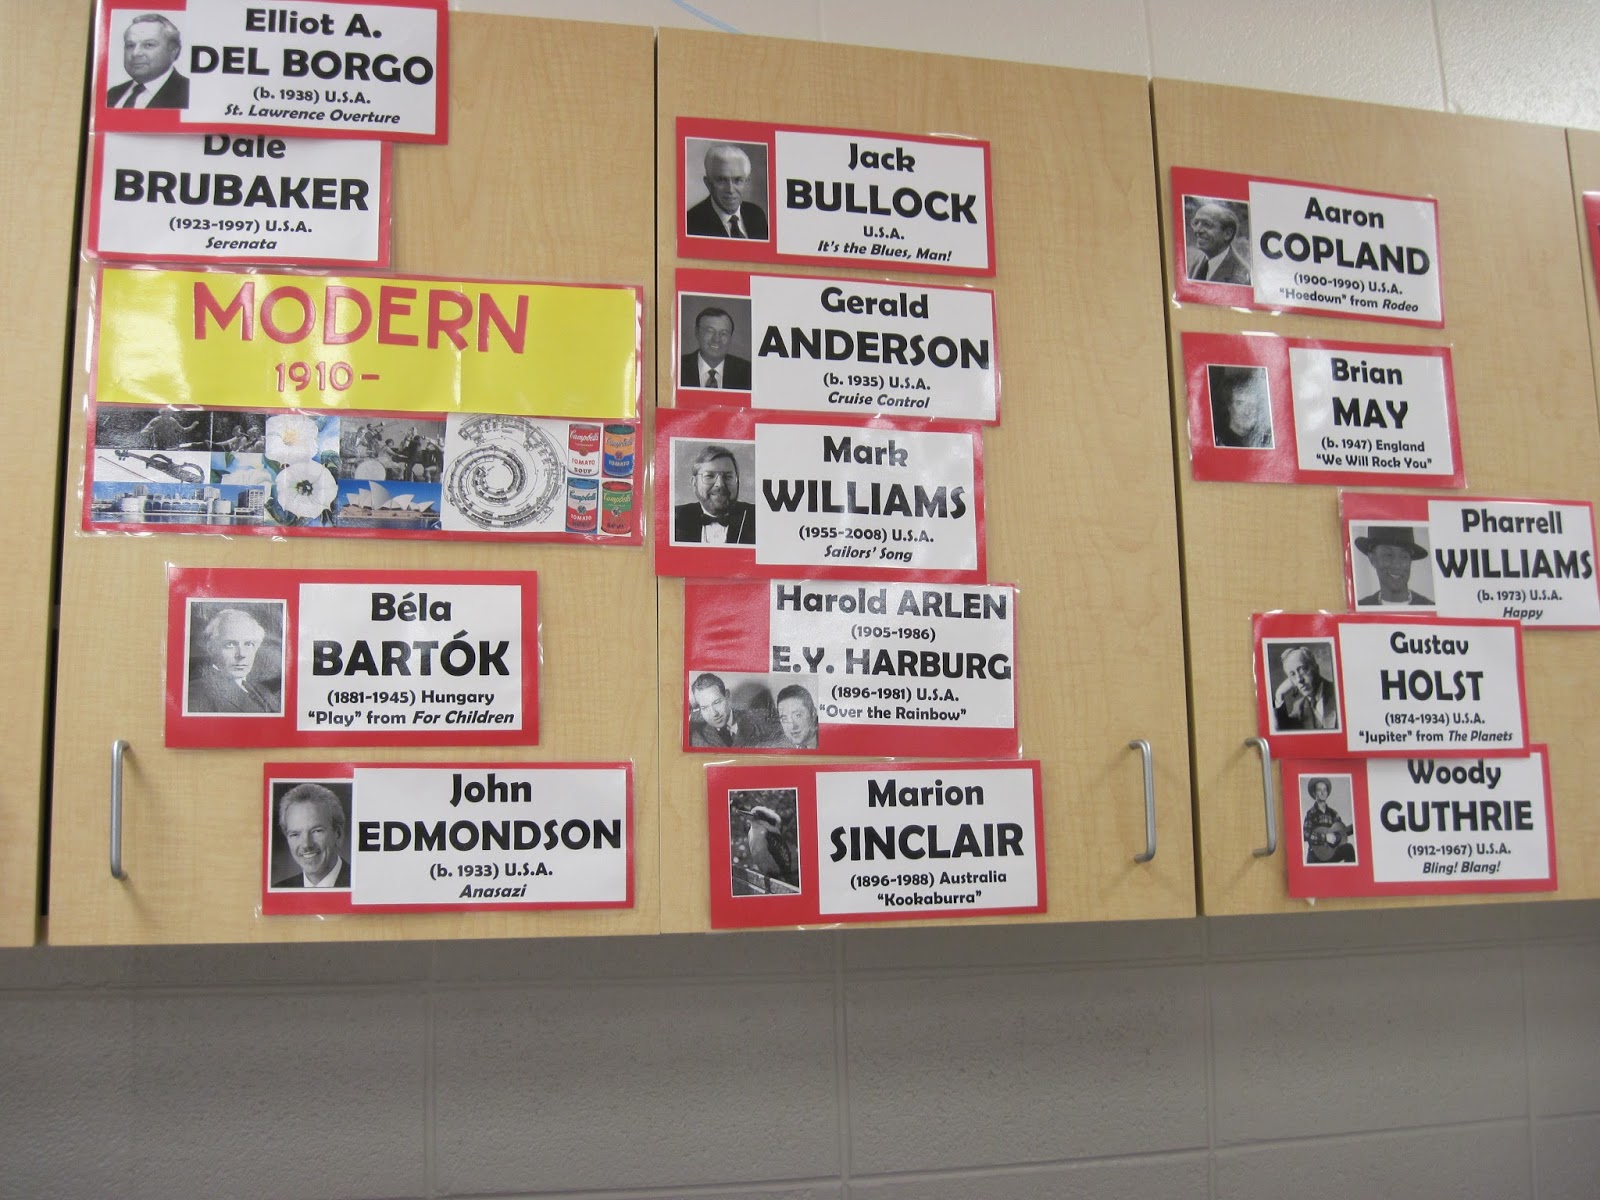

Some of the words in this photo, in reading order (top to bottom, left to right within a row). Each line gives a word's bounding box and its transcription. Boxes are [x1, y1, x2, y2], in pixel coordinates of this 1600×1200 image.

[246, 8, 334, 35] Elliot
[345, 14, 382, 38] A.
[191, 46, 269, 75] DEL
[283, 49, 433, 85] BORGO
[254, 87, 275, 101] (b.
[280, 89, 319, 104] 1938)
[325, 91, 370, 104] U.S.A.
[225, 104, 243, 115] St.
[248, 105, 325, 120] Lawrence
[330, 109, 400, 123] Overture
[204, 134, 286, 159] Dale
[848, 143, 915, 172] Jack
[114, 169, 369, 210] BRUBAKER
[787, 179, 977, 224] BULLOCK
[1305, 197, 1384, 229] Aaron
[170, 217, 260, 234] (1923-1997)
[266, 220, 312, 232] U.S.A.
[864, 226, 904, 239] U.S.A.
[206, 237, 277, 249] Serenata
[844, 242, 867, 254] the
[871, 244, 911, 259] Blues,
[916, 248, 952, 261] Man!
[1260, 231, 1430, 275] COPLAND
[1294, 273, 1364, 293] (1900-1990)
[1369, 281, 1402, 294] U.S.A.
[821, 287, 928, 319] Gerald
[1350, 295, 1378, 308] from
[1383, 299, 1418, 312] Rodeo
[193, 282, 529, 354] MODERN
[758, 326, 989, 369] ANDERSON
[824, 373, 843, 387] (b.
[848, 375, 884, 390] 1935)
[889, 376, 930, 390] U.S.A.
[1331, 358, 1402, 385] Brian
[828, 392, 873, 405] Cruise
[877, 394, 930, 408] Control
[1332, 397, 1408, 429] MAY
[824, 436, 908, 466] Mark
[1322, 437, 1338, 450] (b.
[1342, 439, 1372, 452] 1947)
[1376, 440, 1425, 453] England
[1346, 455, 1368, 466] Will
[1372, 456, 1400, 467] Rock
[763, 479, 966, 519] WILLIAMS
[1461, 509, 1562, 534] Pharrell
[799, 525, 887, 543] (1955-2008)
[892, 529, 934, 542] U.S.A.
[879, 547, 912, 562] Song
[1435, 549, 1592, 579] WILLIAMS
[372, 592, 451, 621] Béla
[777, 585, 886, 614] Harold
[897, 590, 1006, 619] ARLEN
[1477, 590, 1493, 603] (b.
[1497, 590, 1526, 603] 1973)
[1530, 590, 1562, 600] U.S.A.
[1503, 607, 1543, 620] Happy
[852, 625, 935, 643] (1905-1986)
[1390, 631, 1468, 655] Gustav
[313, 630, 509, 676] BARTÓK
[773, 646, 834, 673] E.Y.
[846, 649, 1011, 680] HARBURG
[832, 685, 911, 703] (1896-1981)
[917, 688, 959, 701] U.S.A.
[1381, 670, 1483, 701] HOLST
[328, 690, 415, 706] (1881-1945)
[422, 690, 494, 705] Hungary
[367, 711, 405, 724] from
[413, 711, 441, 724] For
[445, 710, 514, 724] Children
[867, 706, 891, 719] the
[1385, 712, 1449, 726] (1874-1934)
[1453, 713, 1485, 724] U.S.A.
[1416, 730, 1443, 741] from
[1449, 730, 1467, 741] The
[1471, 730, 1512, 741] Planets
[1407, 759, 1501, 789] Woody
[450, 773, 531, 807] John
[868, 779, 983, 807] Marion
[1380, 801, 1533, 832] GUTHRIE
[359, 819, 621, 851] EDMONDSON
[830, 823, 1024, 862] SINCLAIR
[1408, 844, 1472, 858] (1912-1967)
[1476, 843, 1511, 854] U.S.A.
[430, 864, 452, 880] (b.
[458, 863, 499, 880] 1933)
[505, 862, 552, 876] U.S.A.
[1423, 862, 1458, 875] Bling!
[1461, 861, 1500, 874] Blang!
[459, 884, 527, 898] Anasazi
[851, 872, 934, 890] (1896-1988)
[940, 871, 1006, 884] Australia
